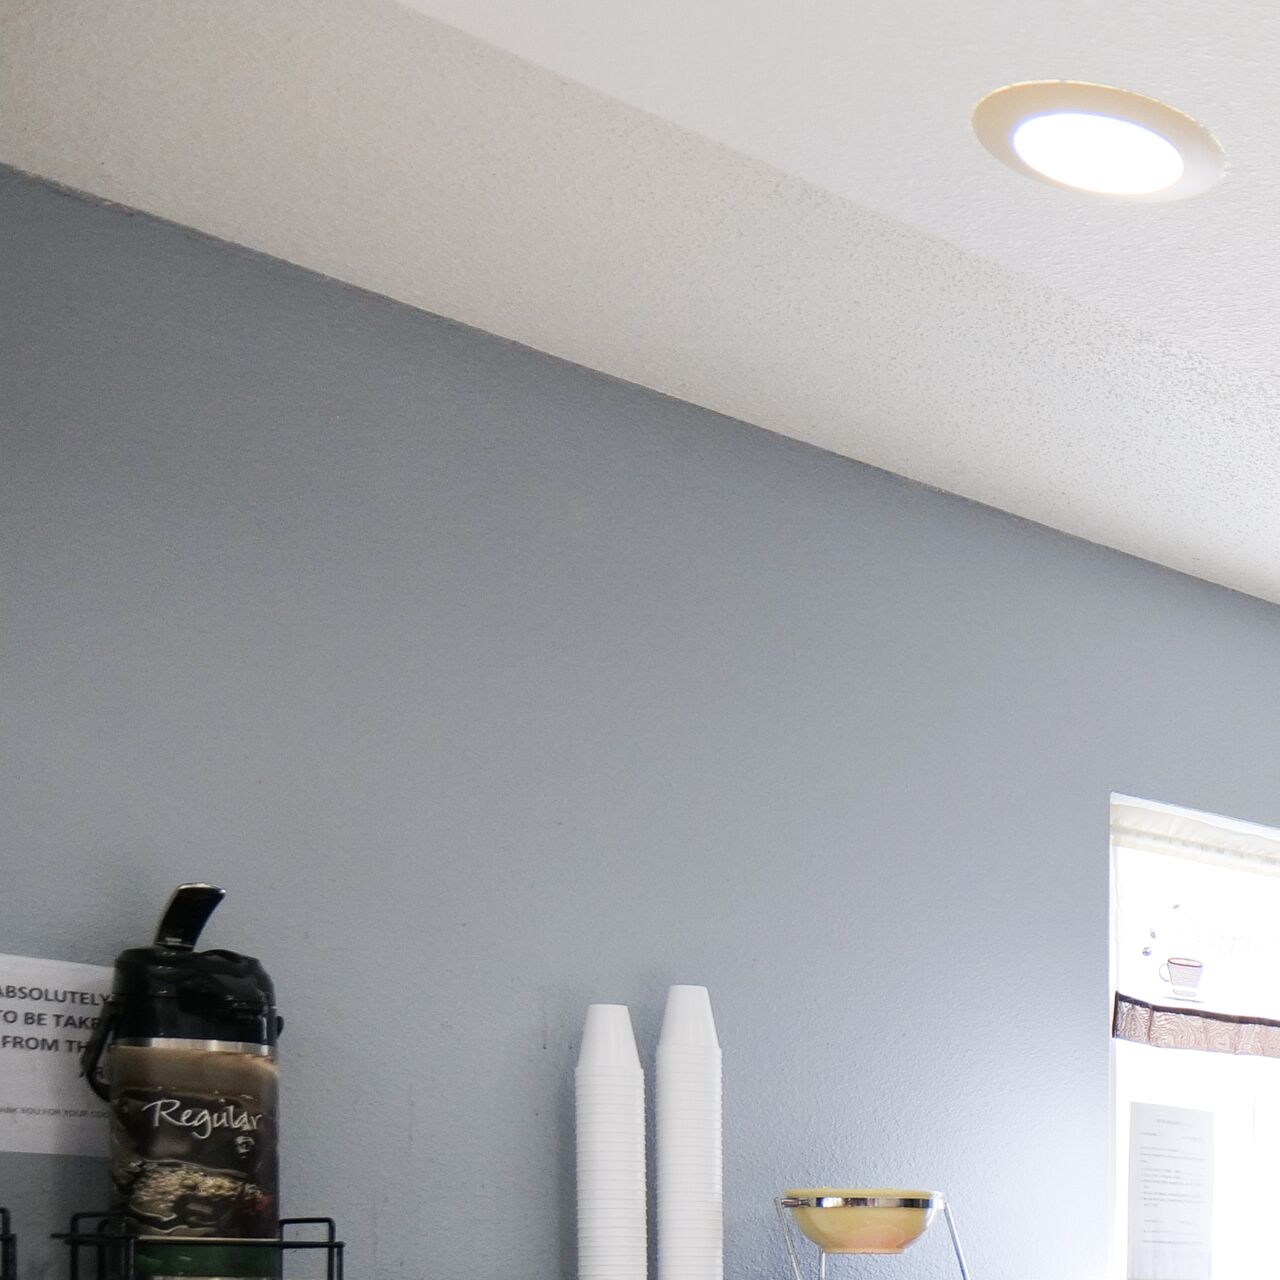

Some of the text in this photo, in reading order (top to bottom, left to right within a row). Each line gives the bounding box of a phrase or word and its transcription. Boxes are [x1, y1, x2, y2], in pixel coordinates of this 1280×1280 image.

[24, 1012, 48, 1026] BE
[2, 1035, 60, 1052] FROM
[141, 1099, 263, 1139] Regular
